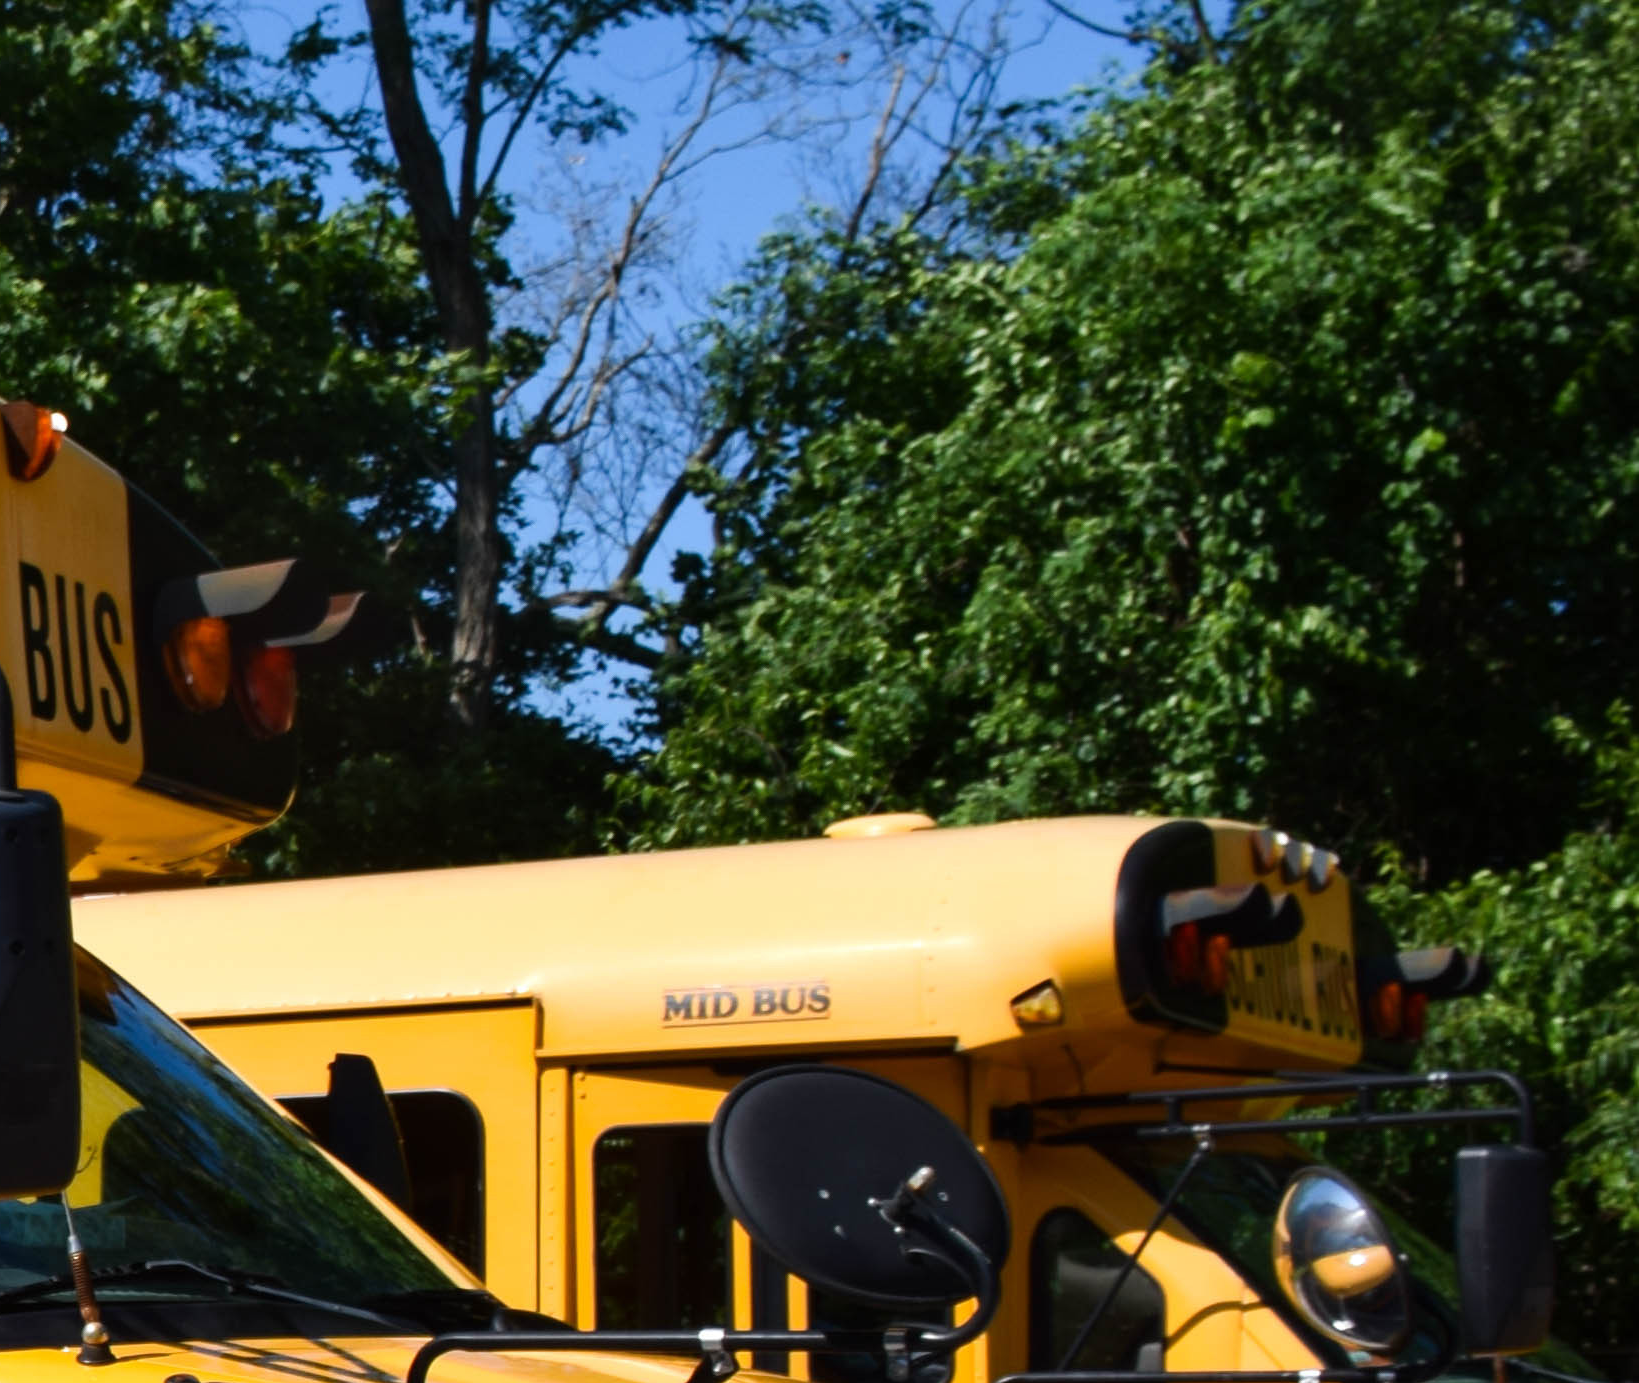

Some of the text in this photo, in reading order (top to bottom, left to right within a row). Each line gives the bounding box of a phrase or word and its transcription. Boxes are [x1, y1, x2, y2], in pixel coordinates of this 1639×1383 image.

[19, 560, 133, 745] BUS
[663, 985, 831, 1022] MID BUS
